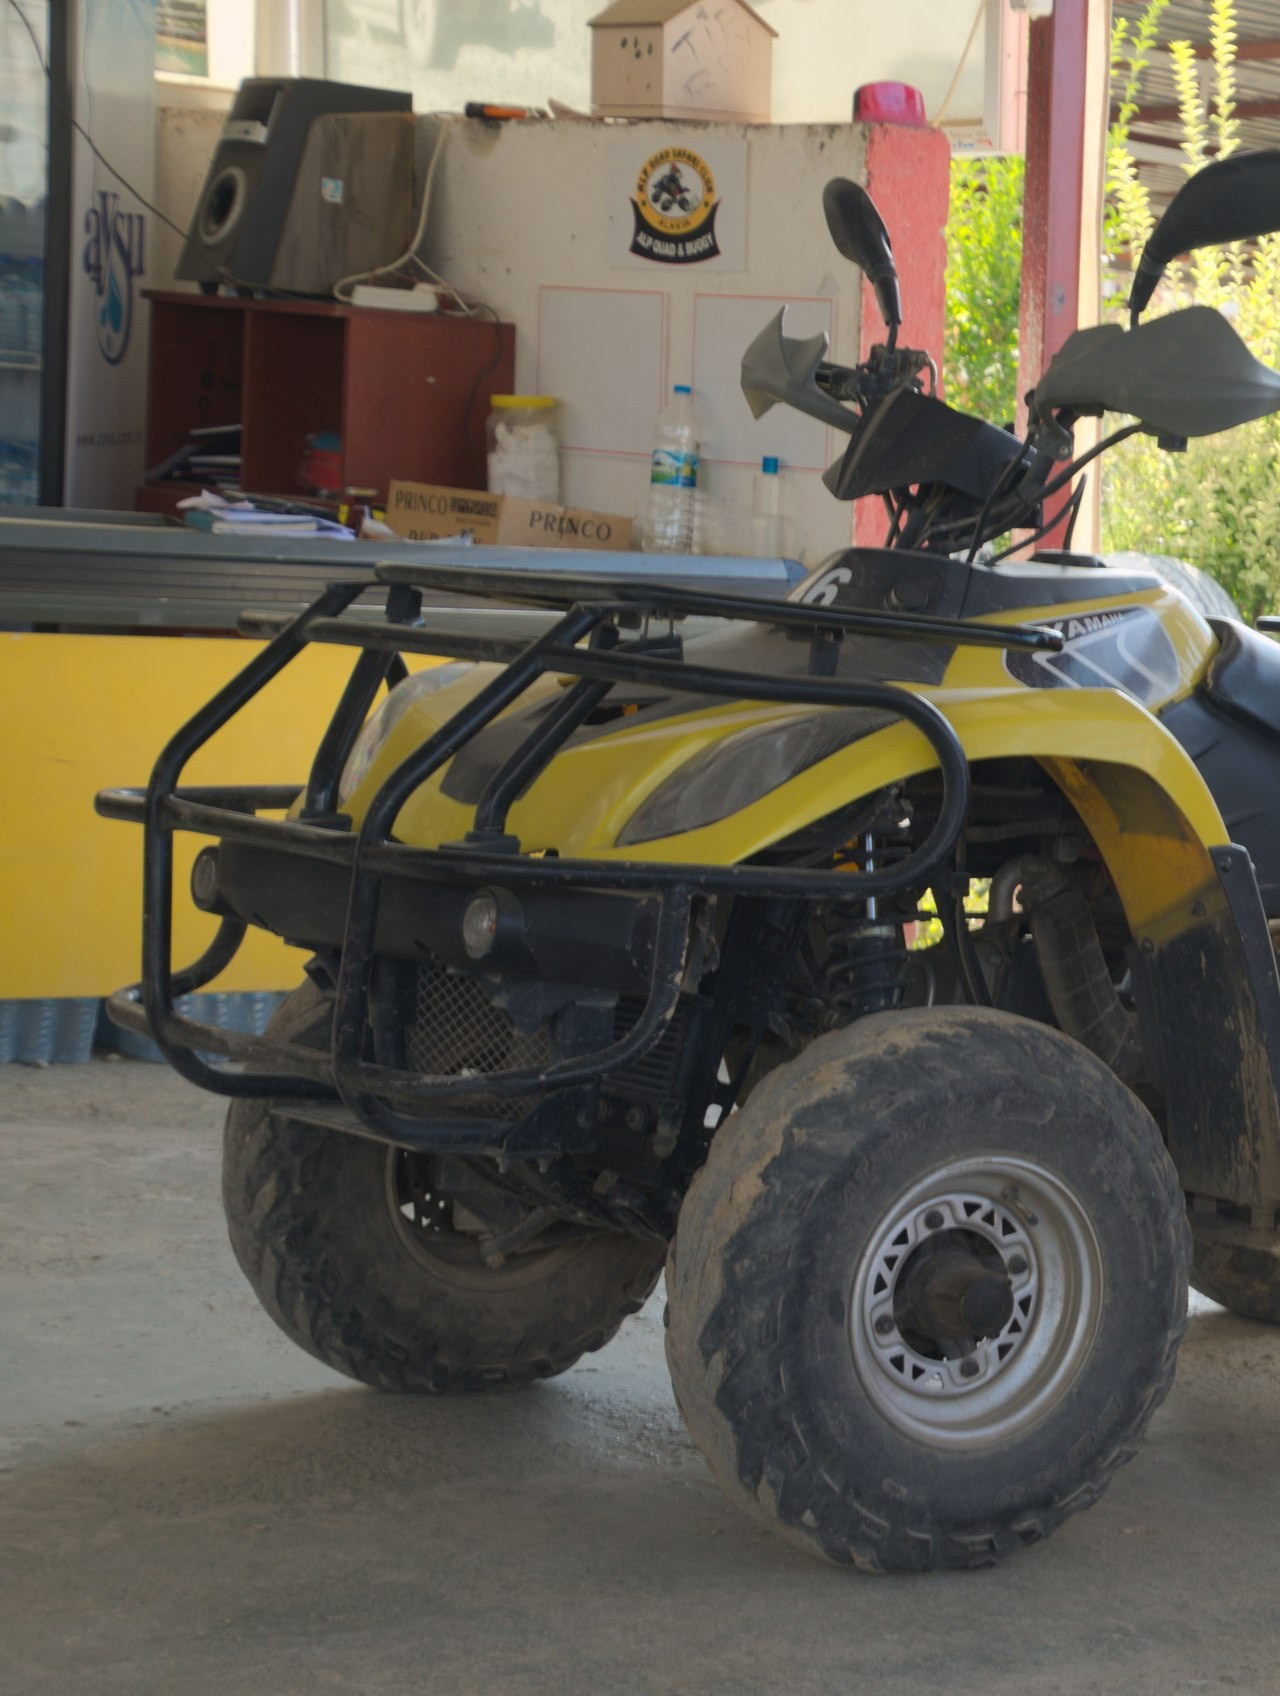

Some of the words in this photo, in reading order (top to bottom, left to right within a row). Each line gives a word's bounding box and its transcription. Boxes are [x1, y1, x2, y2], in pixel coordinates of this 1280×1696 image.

[649, 150, 670, 167] QUAD
[672, 149, 700, 167] SAFARI
[637, 231, 653, 249] ALP
[653, 239, 676, 255] QUAD
[677, 242, 684, 257] &
[686, 232, 713, 255] BUGGY
[395, 489, 448, 514] PRINCO
[529, 510, 613, 542] PRINCO
